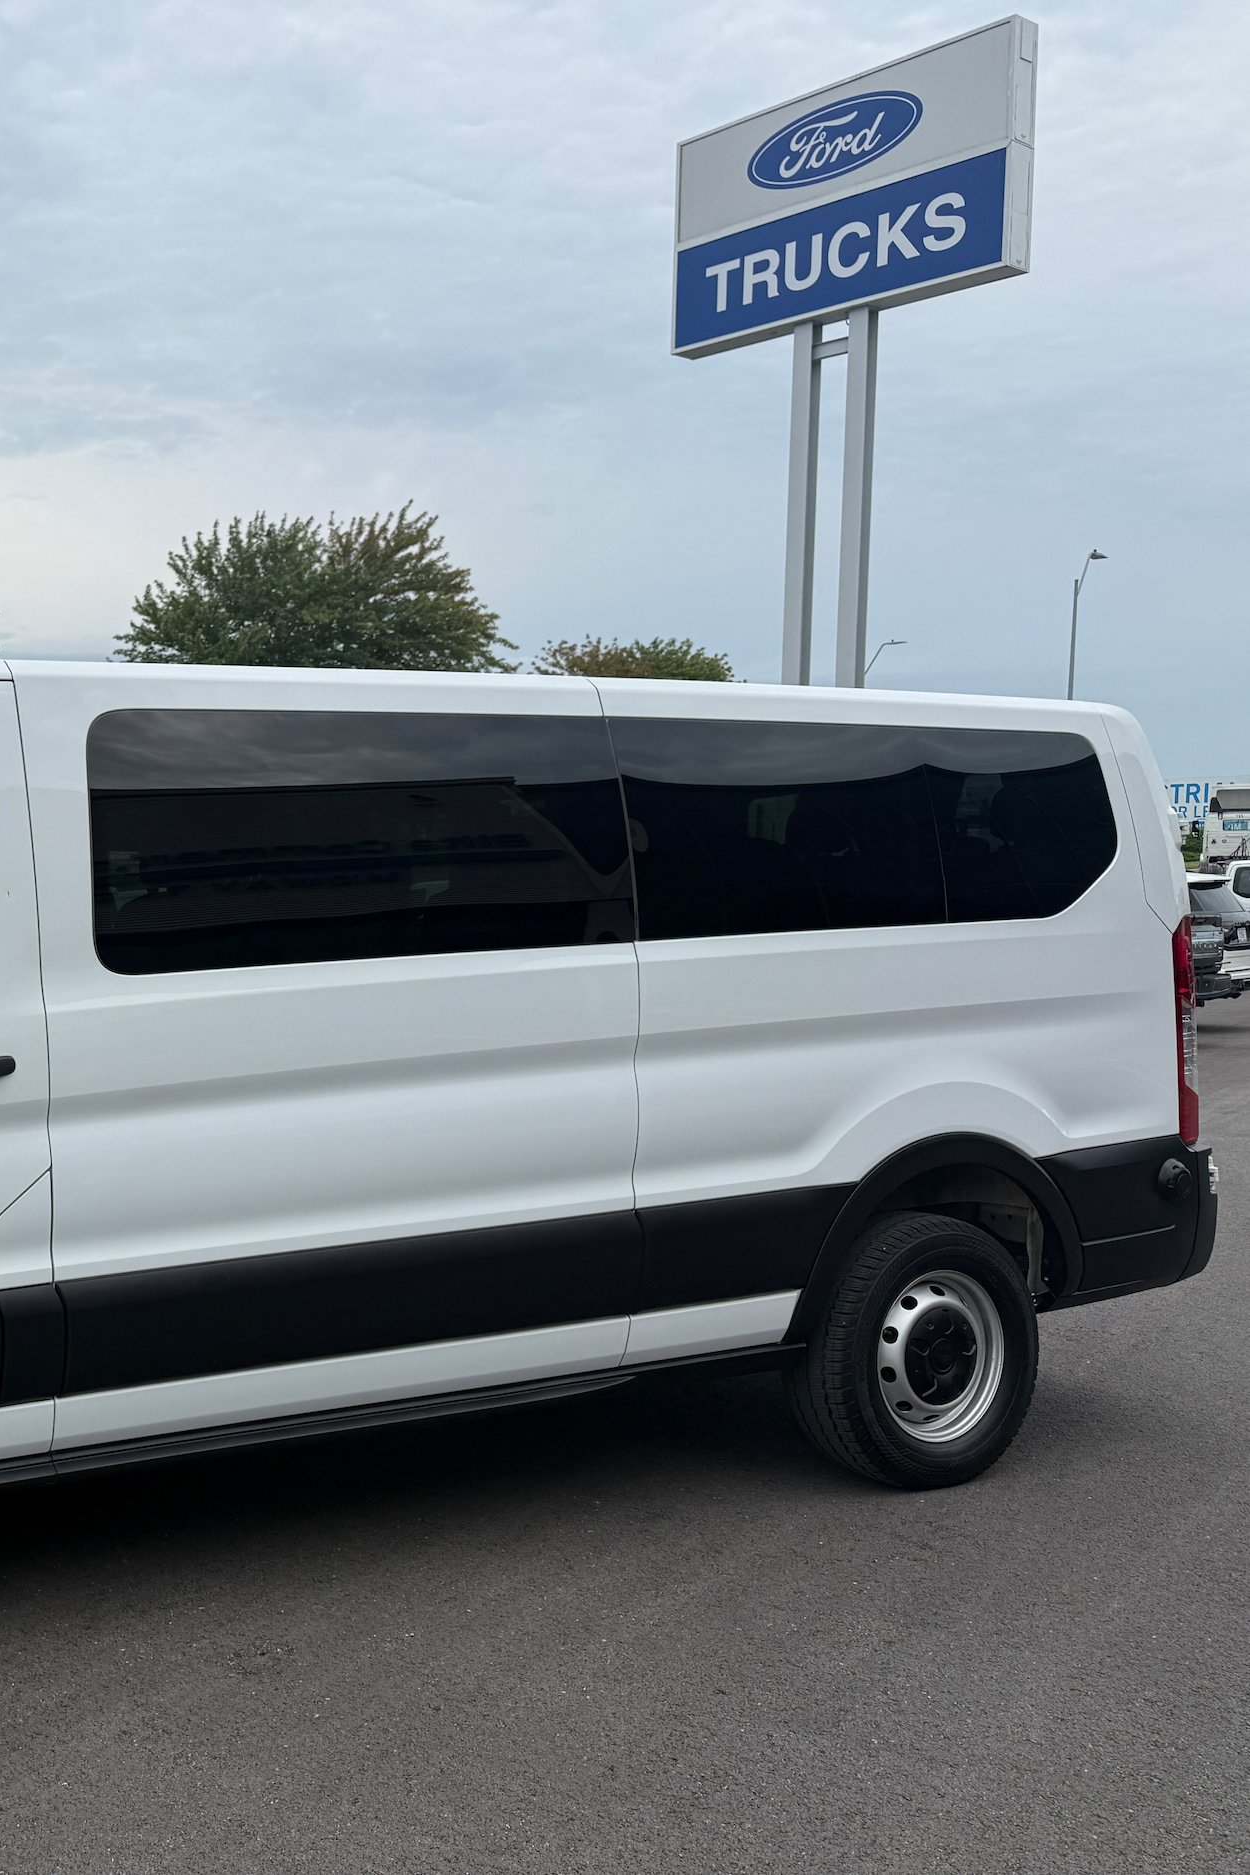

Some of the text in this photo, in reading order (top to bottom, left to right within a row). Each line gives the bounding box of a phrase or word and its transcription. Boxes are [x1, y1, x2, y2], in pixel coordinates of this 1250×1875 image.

[778, 110, 886, 179] Ford
[705, 192, 967, 313] TRUCKS
[1164, 783, 1209, 804] TRI
